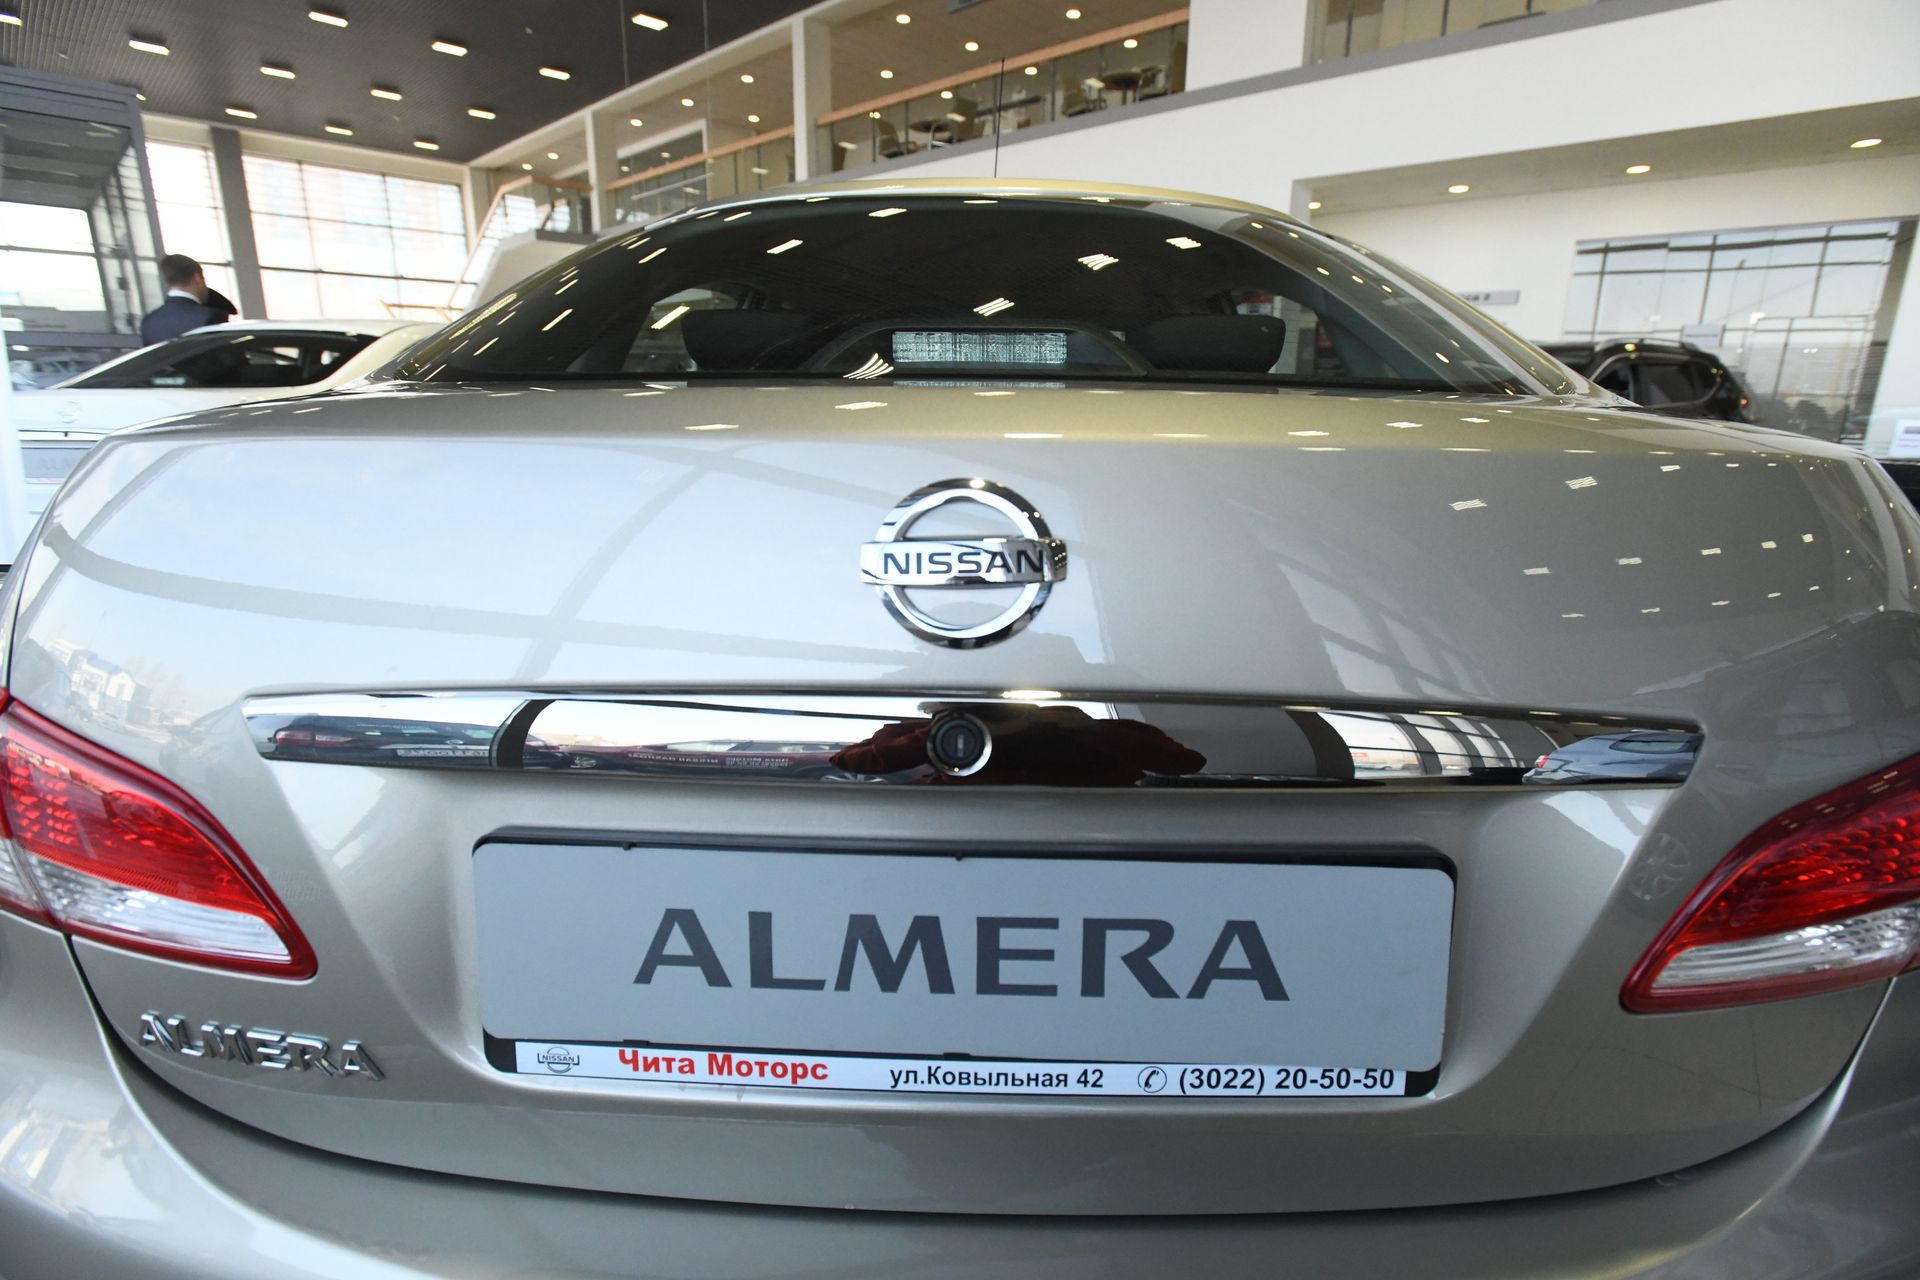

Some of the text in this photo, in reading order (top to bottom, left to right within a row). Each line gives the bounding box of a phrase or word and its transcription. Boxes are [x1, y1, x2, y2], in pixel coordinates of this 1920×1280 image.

[883, 549, 1044, 575] NISSAN
[632, 907, 1290, 1002] ALMERA
[139, 1010, 386, 1081] ALMERA
[541, 1054, 575, 1063] NISSAN
[618, 1048, 829, 1085] Чита Моторс
[889, 1065, 1104, 1089] ул.Ковыльная 42
[1179, 1067, 1395, 1095] (3022) 20-50-50
